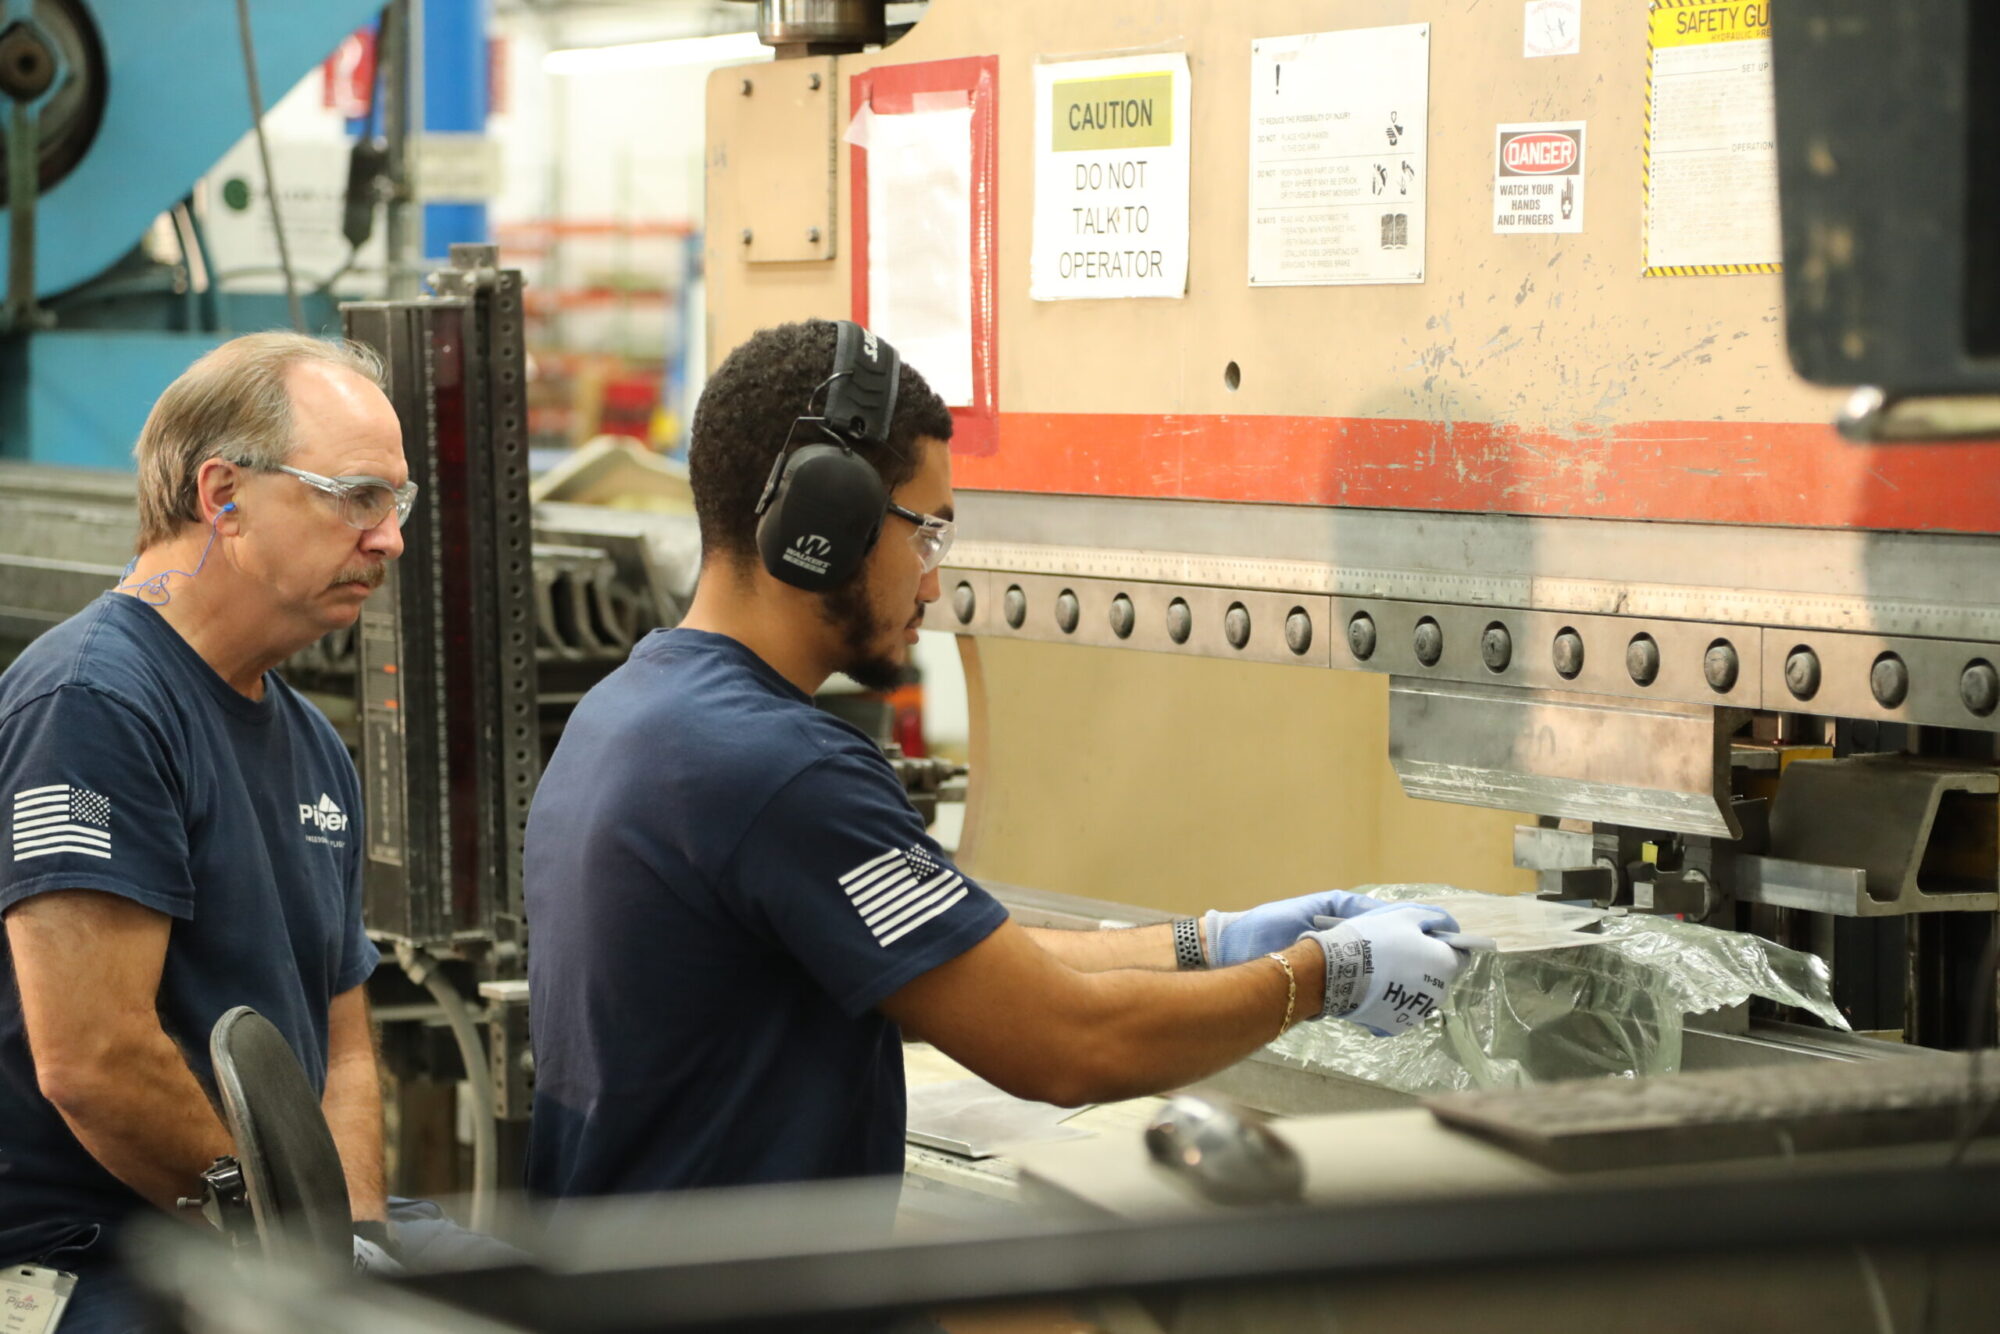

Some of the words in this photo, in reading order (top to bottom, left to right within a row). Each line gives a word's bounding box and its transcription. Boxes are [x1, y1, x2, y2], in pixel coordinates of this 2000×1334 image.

[1676, 7, 1740, 35] SAFETY
[1742, 64, 1756, 73] SET
[1759, 62, 1769, 72] UP
[1068, 98, 1153, 132] CAUTION
[1508, 140, 1573, 166] DANGER
[1731, 141, 1774, 153] OPERATION
[1076, 162, 1103, 191] DO
[1108, 160, 1148, 190] NOT
[1500, 184, 1529, 196] WATCH
[1531, 183, 1554, 195] YOUR
[1511, 199, 1541, 211] HANDS
[1072, 206, 1118, 235] TALK
[1124, 205, 1149, 234] TO
[1497, 214, 1516, 226] AND
[1517, 214, 1554, 226] FINGERS
[1059, 250, 1163, 279] OPERATOR
[298, 803, 349, 832] Piper
[1362, 939, 1375, 975] Ansell
[5, 1295, 39, 1312] Piper
